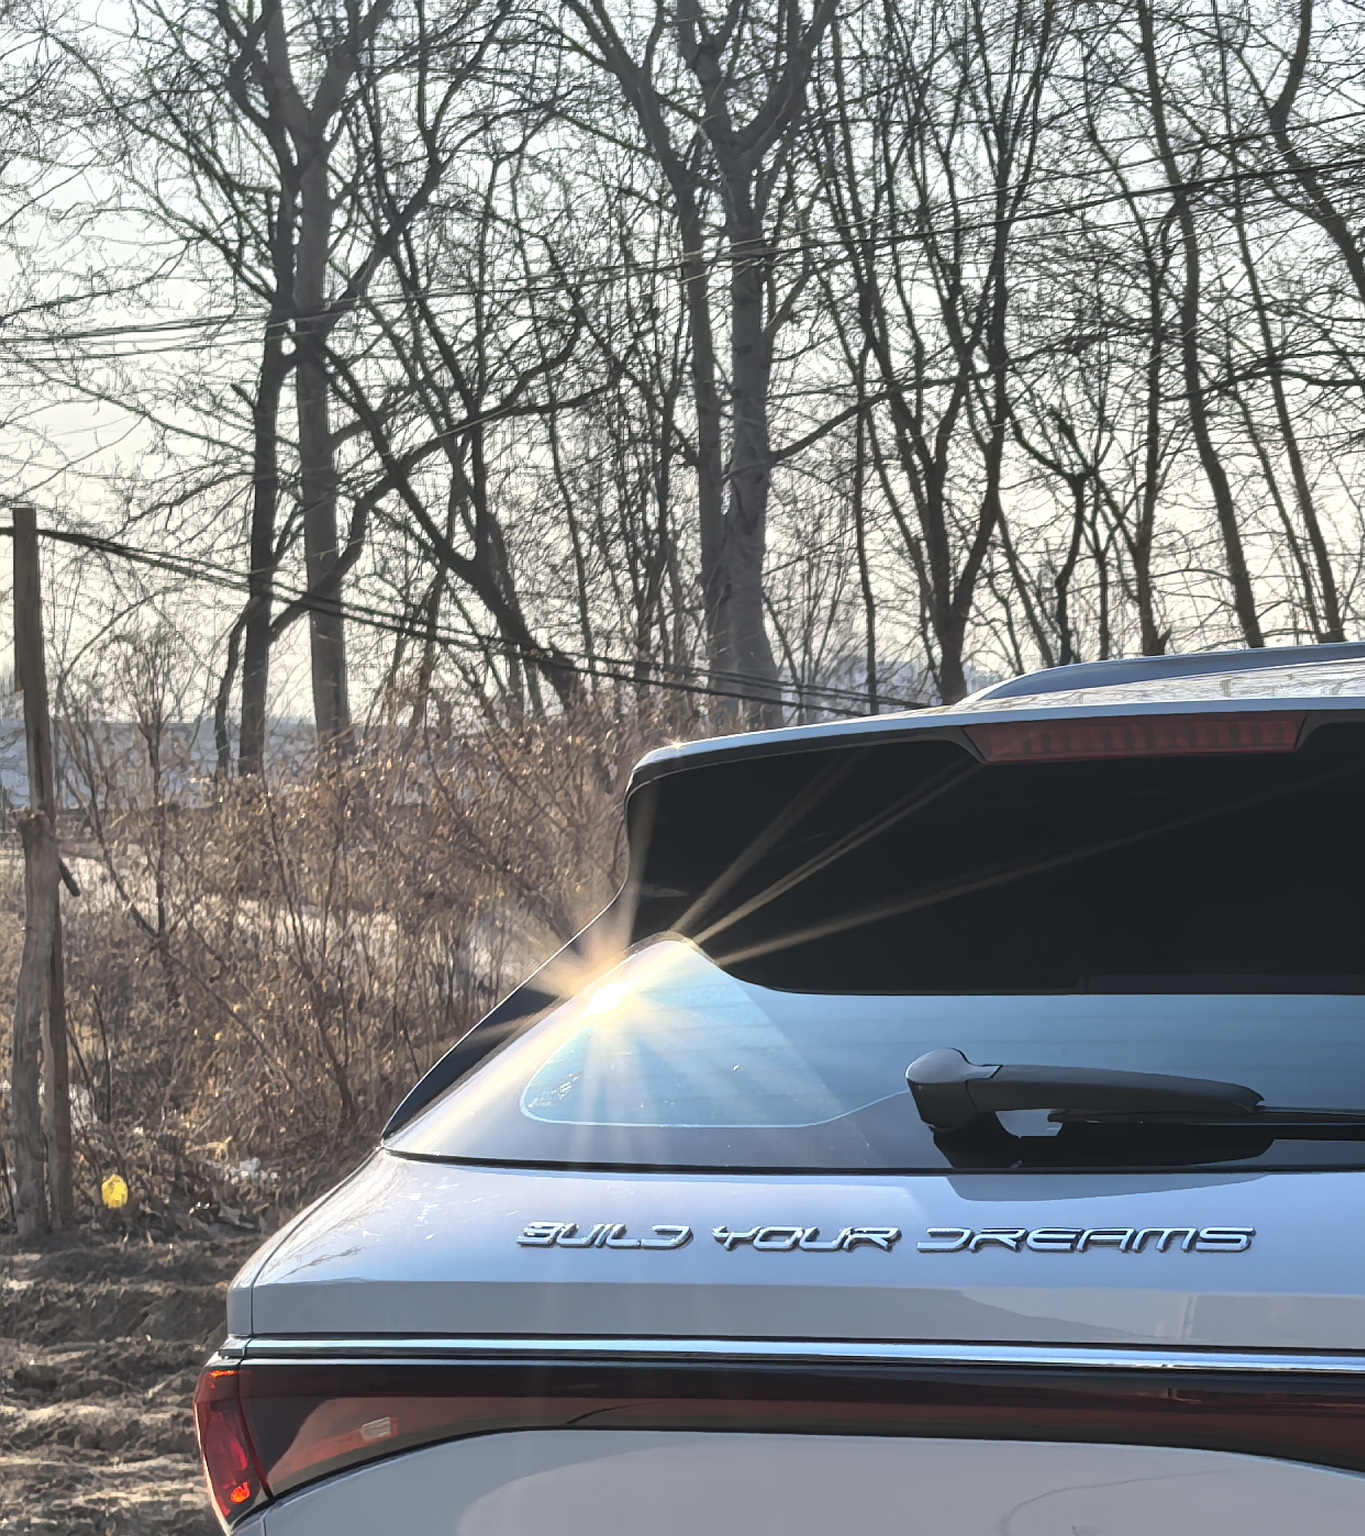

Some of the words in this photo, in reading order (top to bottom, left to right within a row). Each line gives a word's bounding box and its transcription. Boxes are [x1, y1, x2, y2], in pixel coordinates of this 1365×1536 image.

[516, 1220, 693, 1251] BUILD
[711, 1223, 903, 1253] YOUR
[916, 1225, 1256, 1255] DREAMS
